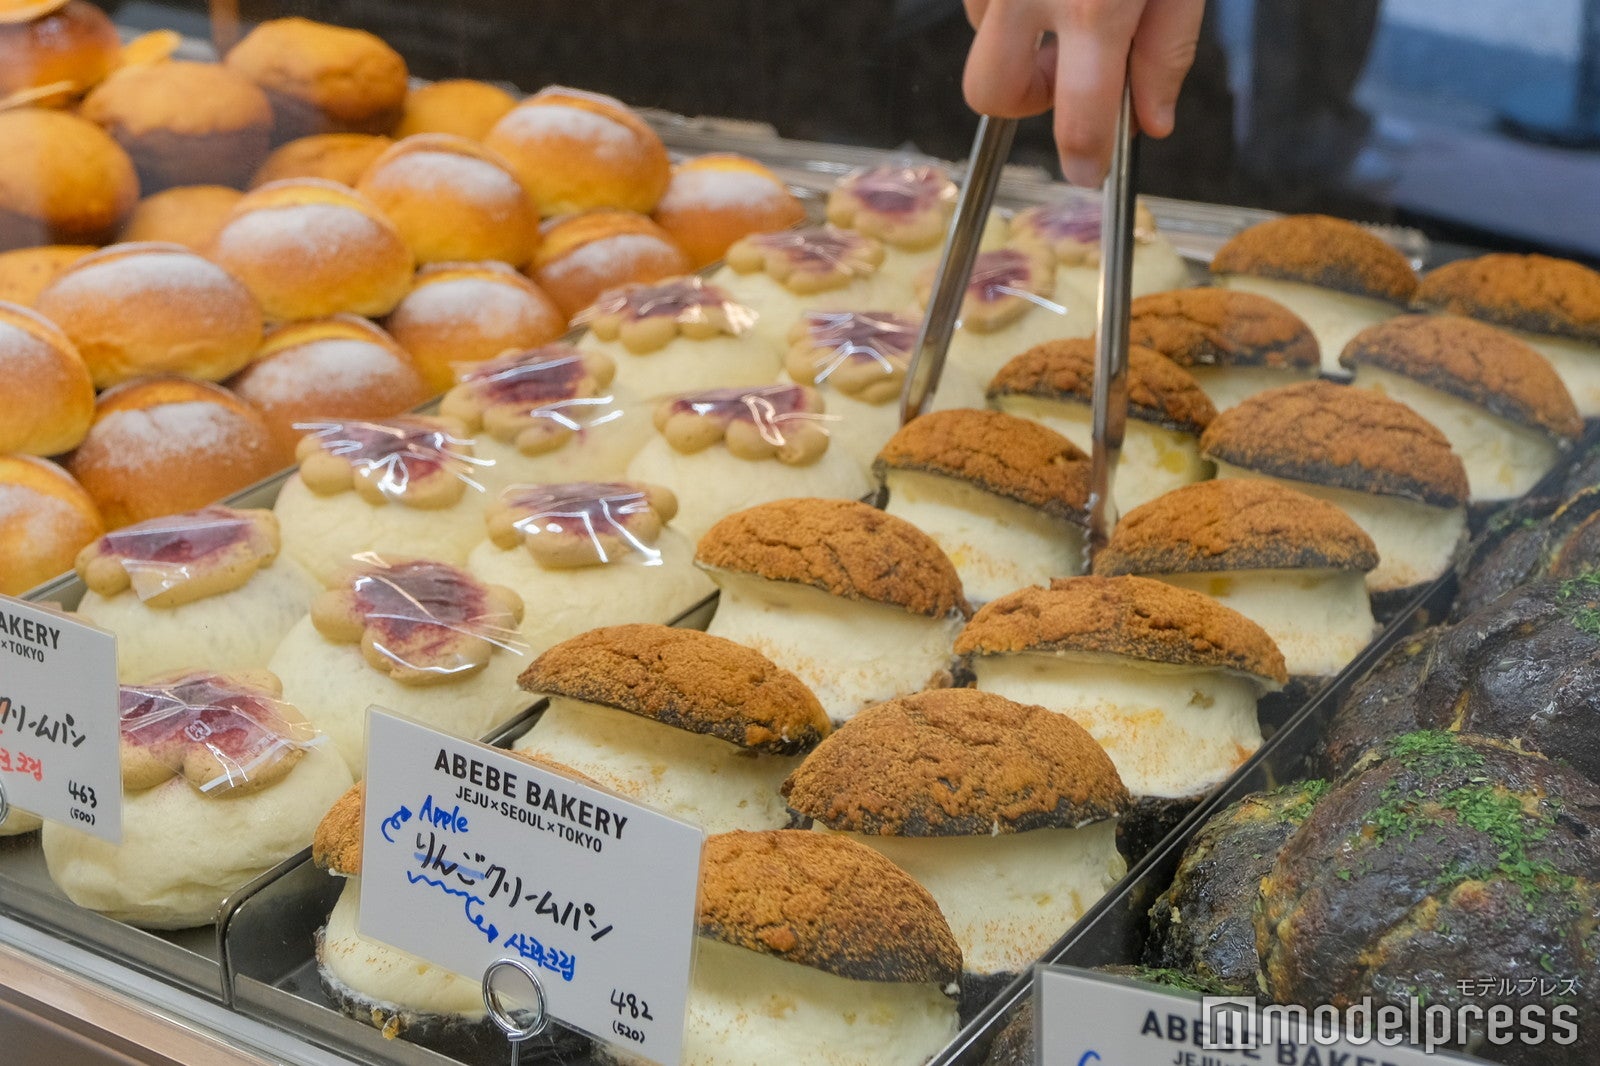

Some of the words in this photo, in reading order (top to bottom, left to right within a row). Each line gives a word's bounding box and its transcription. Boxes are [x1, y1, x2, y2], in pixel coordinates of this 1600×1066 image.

[68, 779, 97, 809] 463
[434, 749, 517, 798] ABEBE
[526, 780, 628, 840] BAKERY
[70, 806, 95, 826] (500)
[419, 794, 469, 833] Apple
[415, 832, 613, 942] りんごクリームパン
[610, 988, 653, 1021] 482
[612, 1022, 646, 1044] (520)
